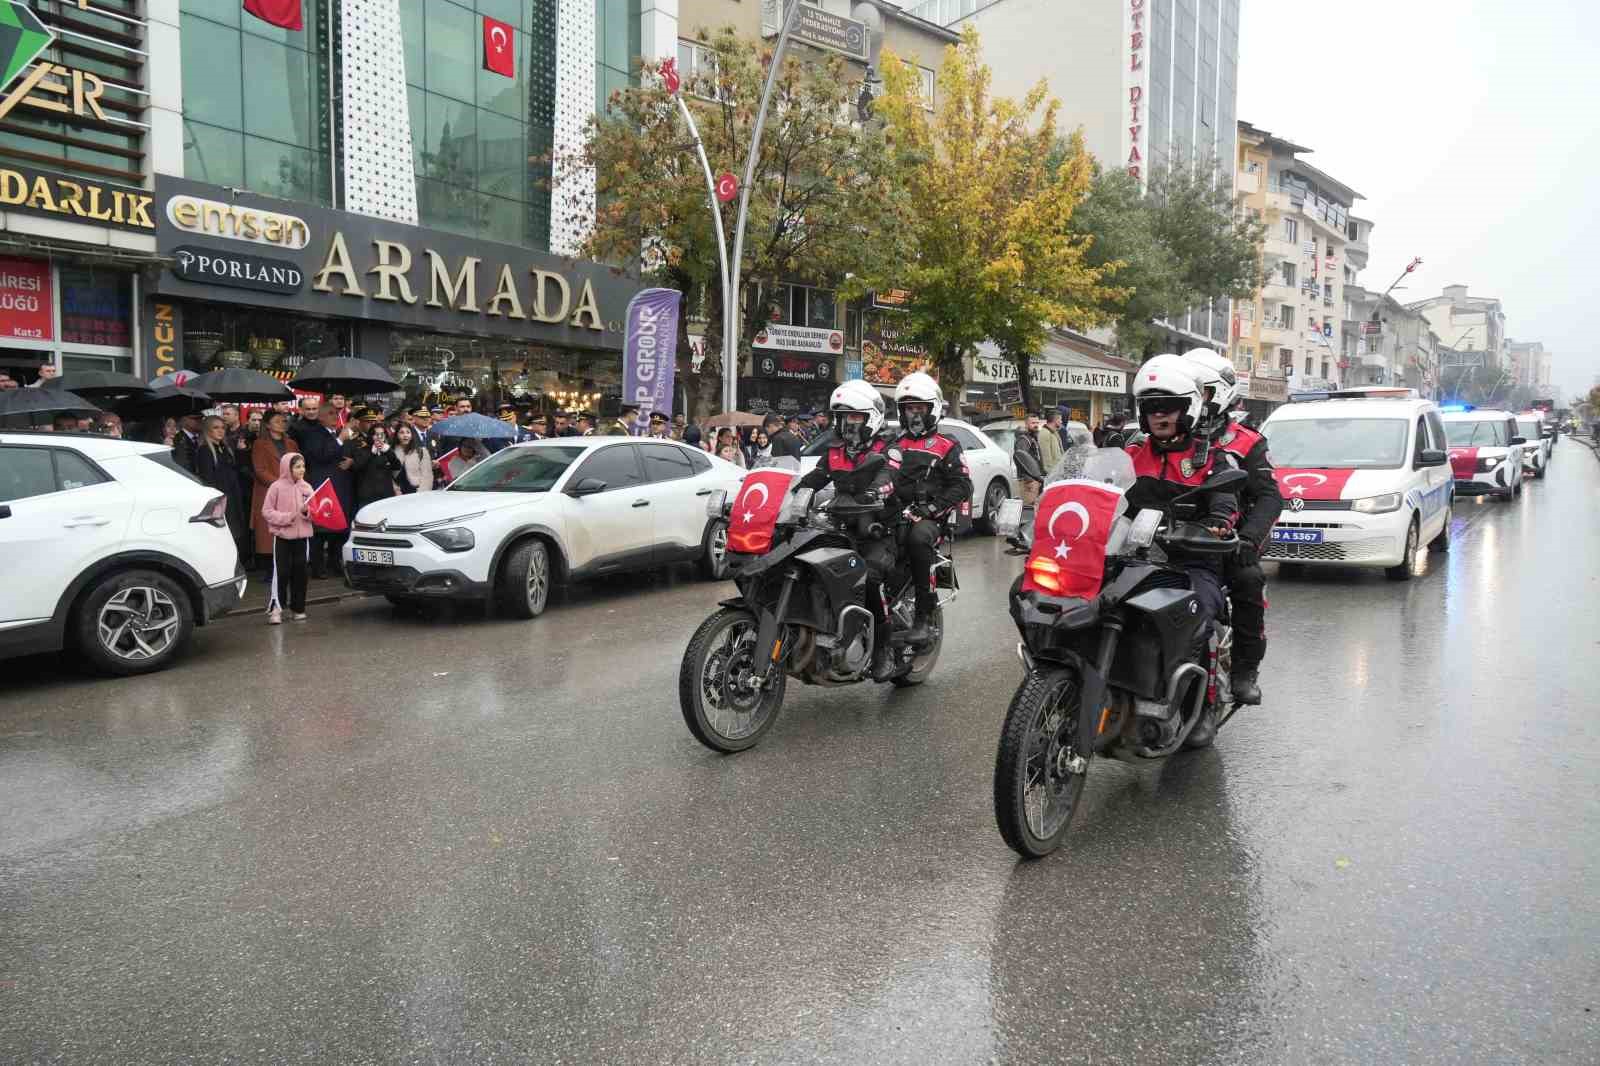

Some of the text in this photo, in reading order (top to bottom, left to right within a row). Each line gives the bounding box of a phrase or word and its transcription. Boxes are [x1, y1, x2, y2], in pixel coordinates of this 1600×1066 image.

[174, 199, 306, 246] emsan
[198, 255, 302, 287] PORLAND
[312, 231, 605, 331] ARMADA
[0, 271, 41, 293] İRESİ
[0, 294, 39, 312] ÜĞÜ
[418, 373, 475, 388] POLAND
[1030, 367, 1047, 381] AL
[1050, 368, 1069, 383] EVİ
[1071, 374, 1082, 385] ve
[1084, 373, 1120, 387] AKTAR
[1282, 531, 1290, 540] A
[1293, 532, 1317, 540] 5367
